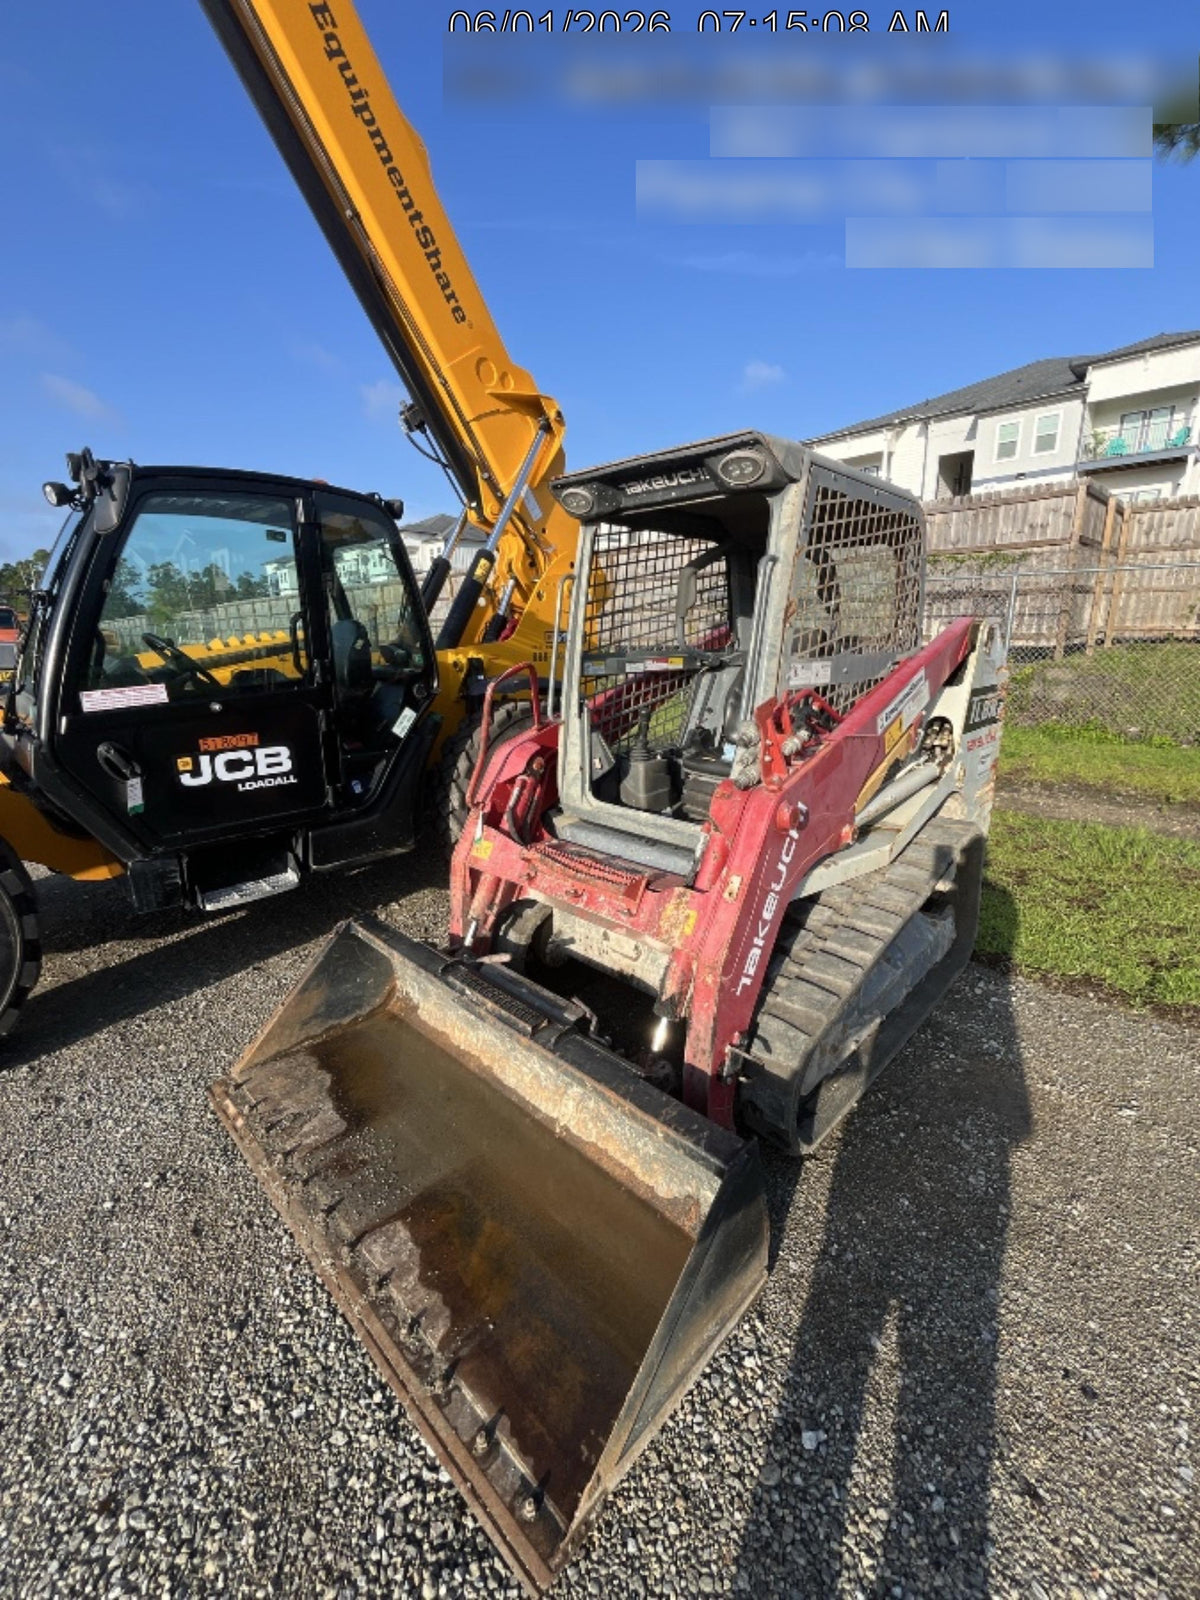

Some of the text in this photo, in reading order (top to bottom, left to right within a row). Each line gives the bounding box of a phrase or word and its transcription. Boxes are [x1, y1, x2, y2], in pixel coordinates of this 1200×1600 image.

[308, 0, 468, 325] EquipmentShare
[179, 746, 292, 786] JCB
[237, 775, 297, 791] LOADALL
